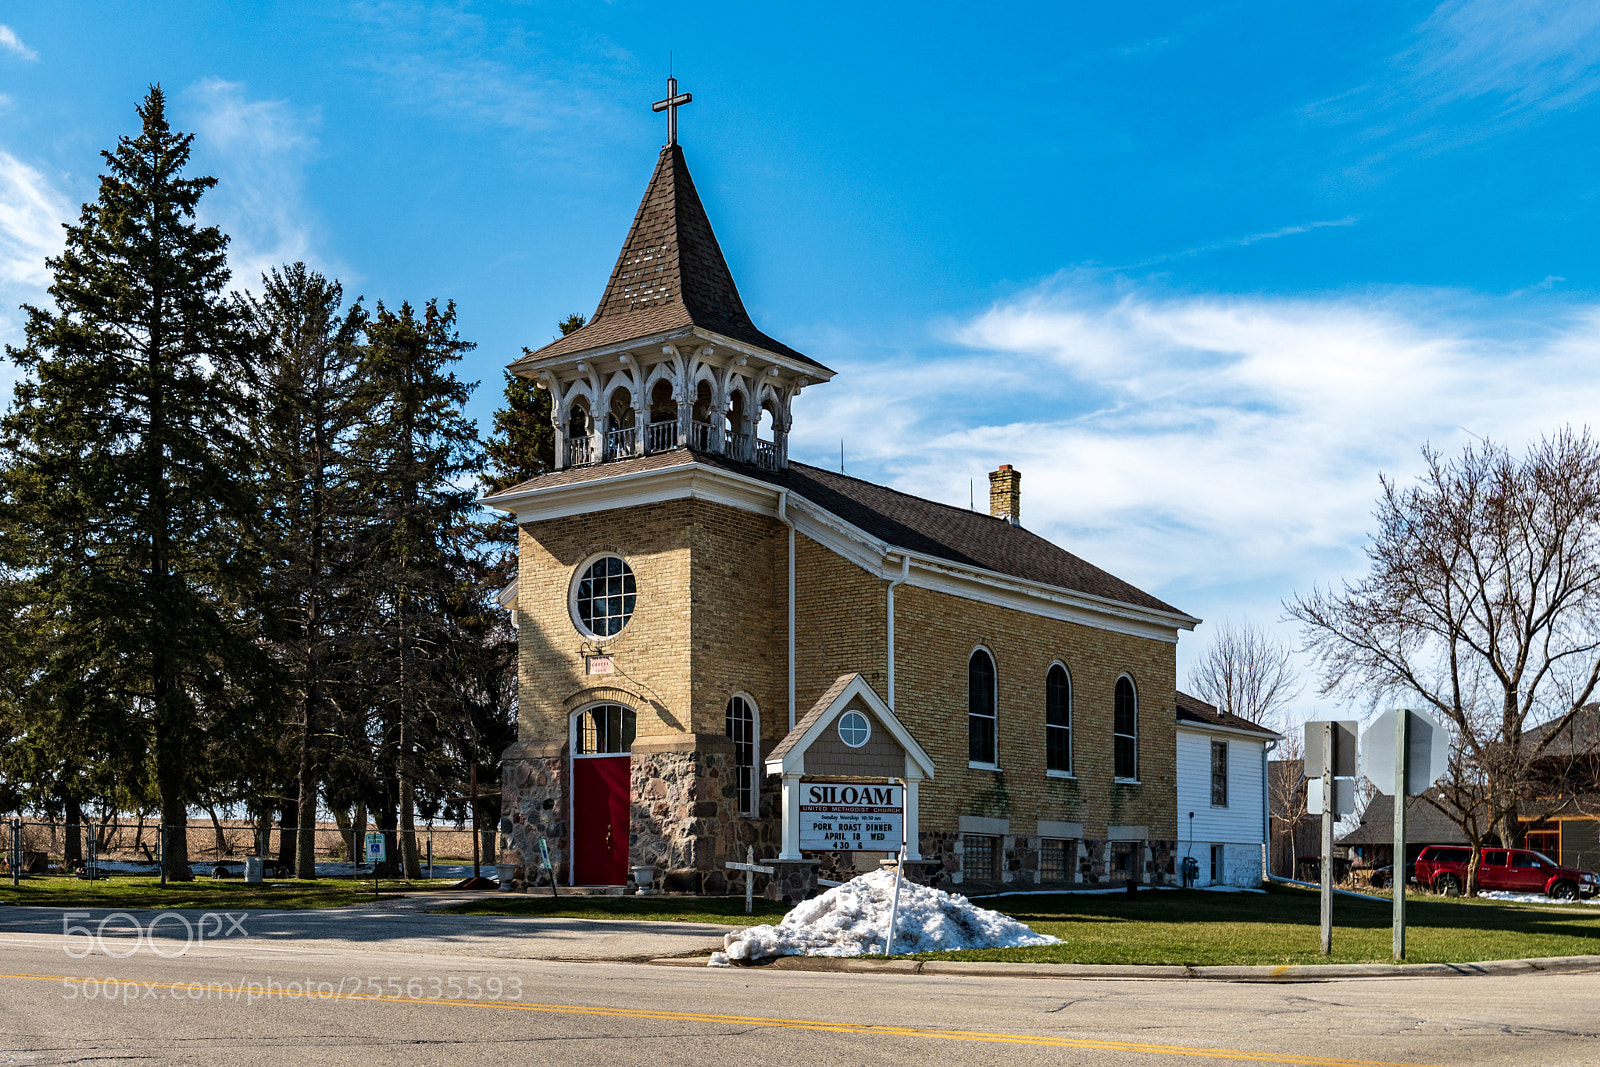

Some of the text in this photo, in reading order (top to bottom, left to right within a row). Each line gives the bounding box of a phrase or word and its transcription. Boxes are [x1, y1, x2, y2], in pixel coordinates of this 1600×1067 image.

[808, 786, 893, 805] SILOAM
[839, 823, 862, 831] ROAST
[866, 823, 893, 831] DINNER
[824, 832, 846, 840] APRIL
[853, 832, 861, 840] 18
